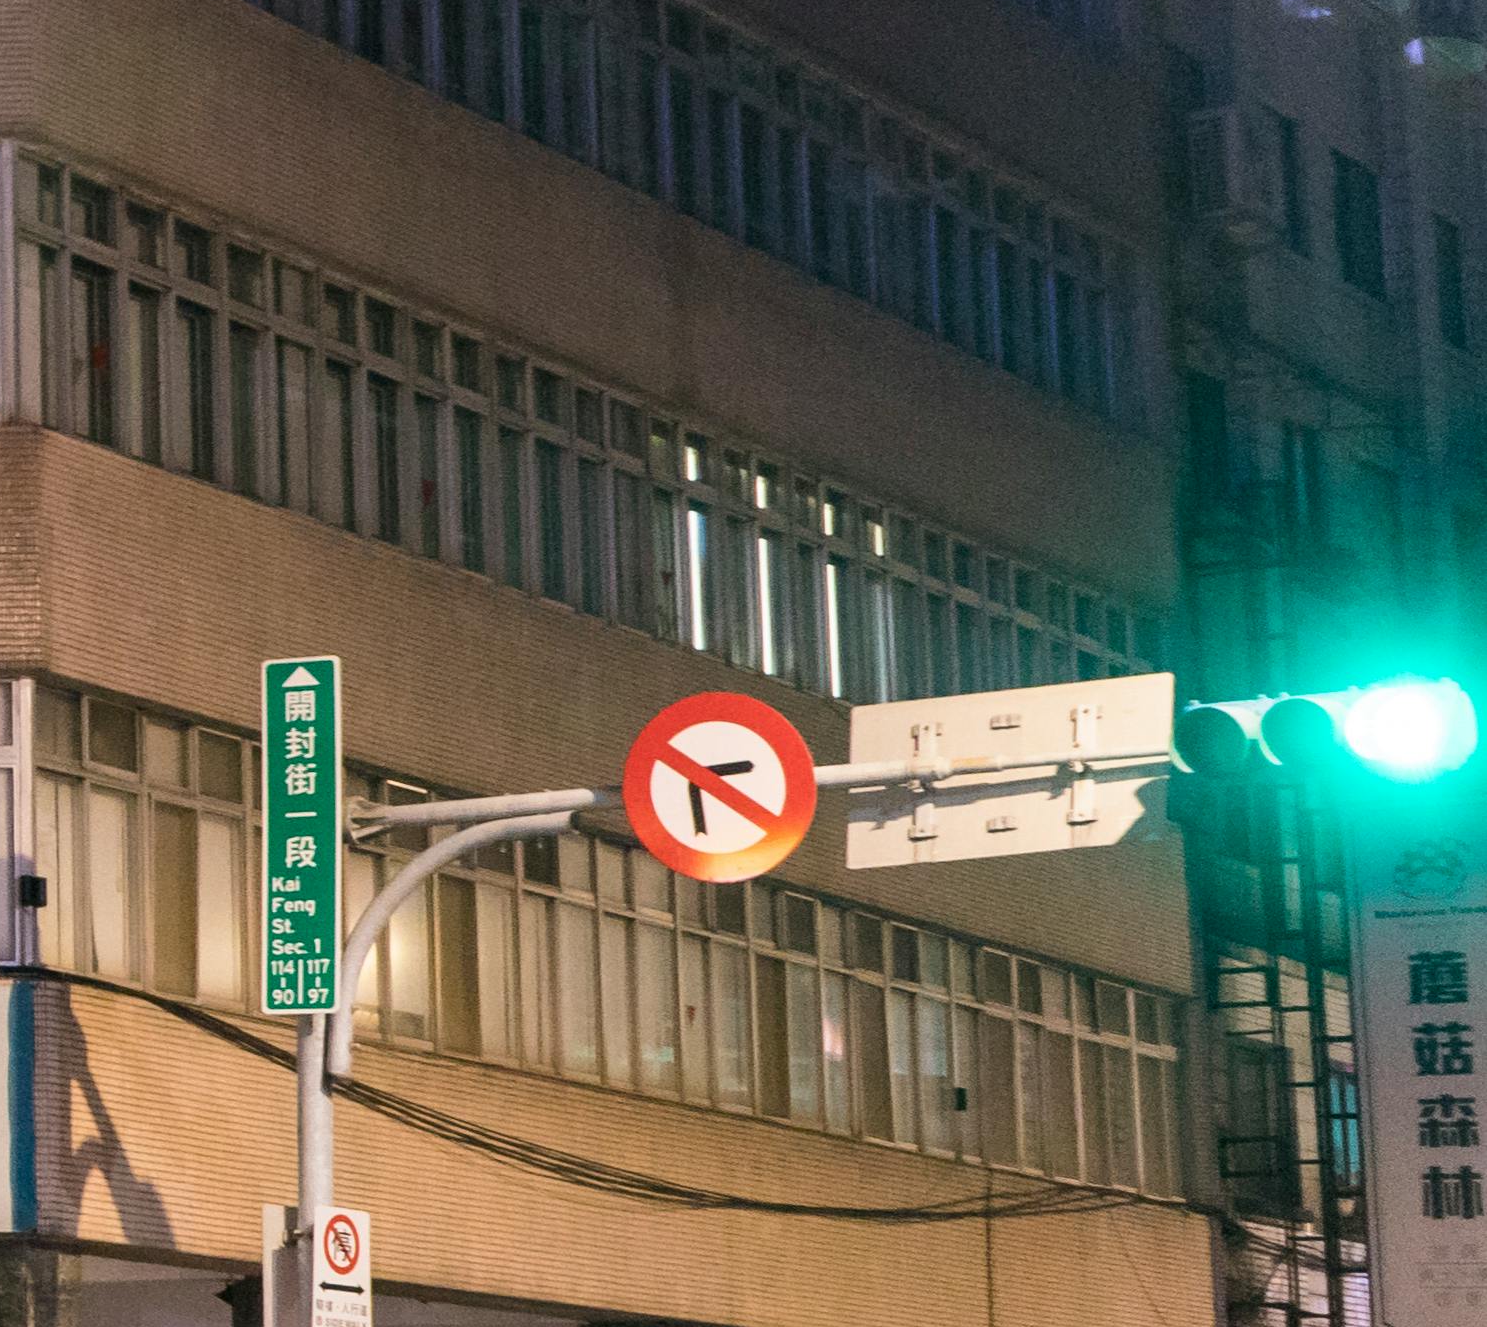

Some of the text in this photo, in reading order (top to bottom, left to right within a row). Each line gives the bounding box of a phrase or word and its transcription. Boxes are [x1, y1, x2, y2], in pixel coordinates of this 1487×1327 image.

[284, 690, 318, 869] 開封街一段
[272, 877, 301, 893] Kai
[272, 898, 316, 917] Feng
[314, 938, 321, 954] 1
[271, 958, 330, 975] 114 117
[272, 988, 329, 1006] 90 97
[1407, 949, 1485, 1220] 蘑菇森林
